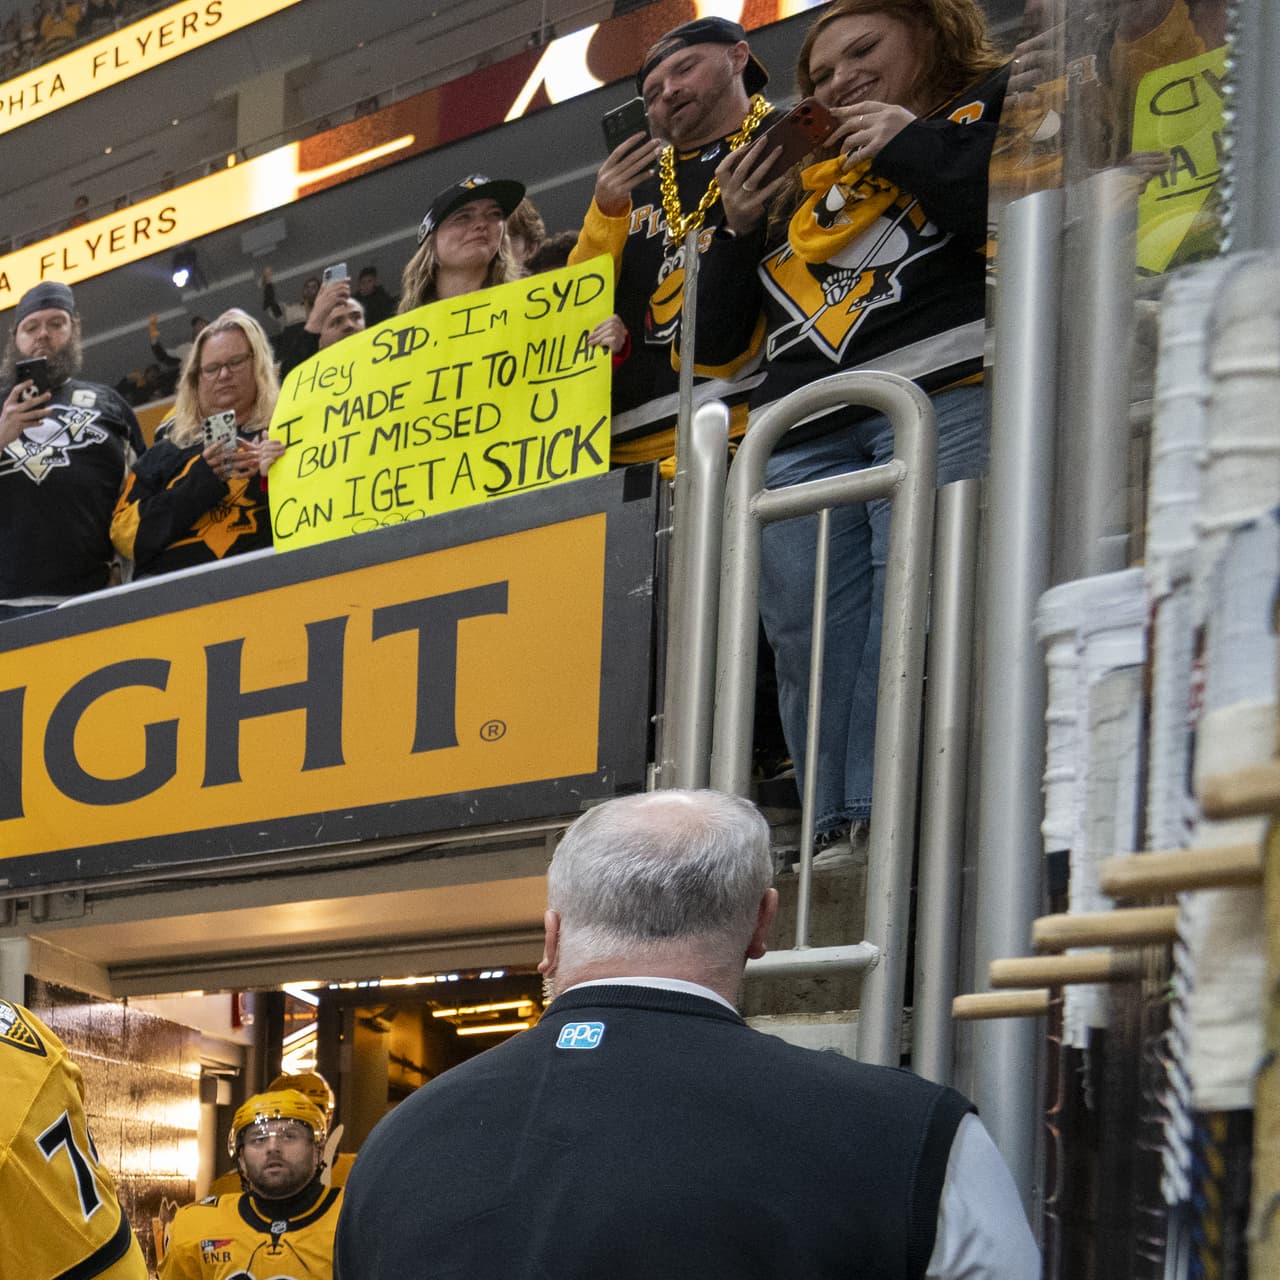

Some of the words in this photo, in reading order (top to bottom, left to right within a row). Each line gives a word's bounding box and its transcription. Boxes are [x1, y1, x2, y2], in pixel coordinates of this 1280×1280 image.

[93, 1, 225, 78] FLYERS
[40, 206, 180, 280] FLYERS
[293, 357, 357, 401] Hey
[524, 273, 605, 321] SYD
[276, 414, 305, 450] I
[323, 381, 412, 435] MADE
[426, 361, 473, 406] IT
[482, 350, 518, 389] TO
[297, 432, 364, 481] BUT
[369, 402, 502, 457] MISSED
[531, 387, 559, 424] U
[274, 498, 334, 541] CAN
[371, 457, 447, 512] GET
[450, 458, 477, 497] A
[483, 415, 608, 493] STICK
[561, 1024, 601, 1046] PPG
[34, 1108, 105, 1224] 7
